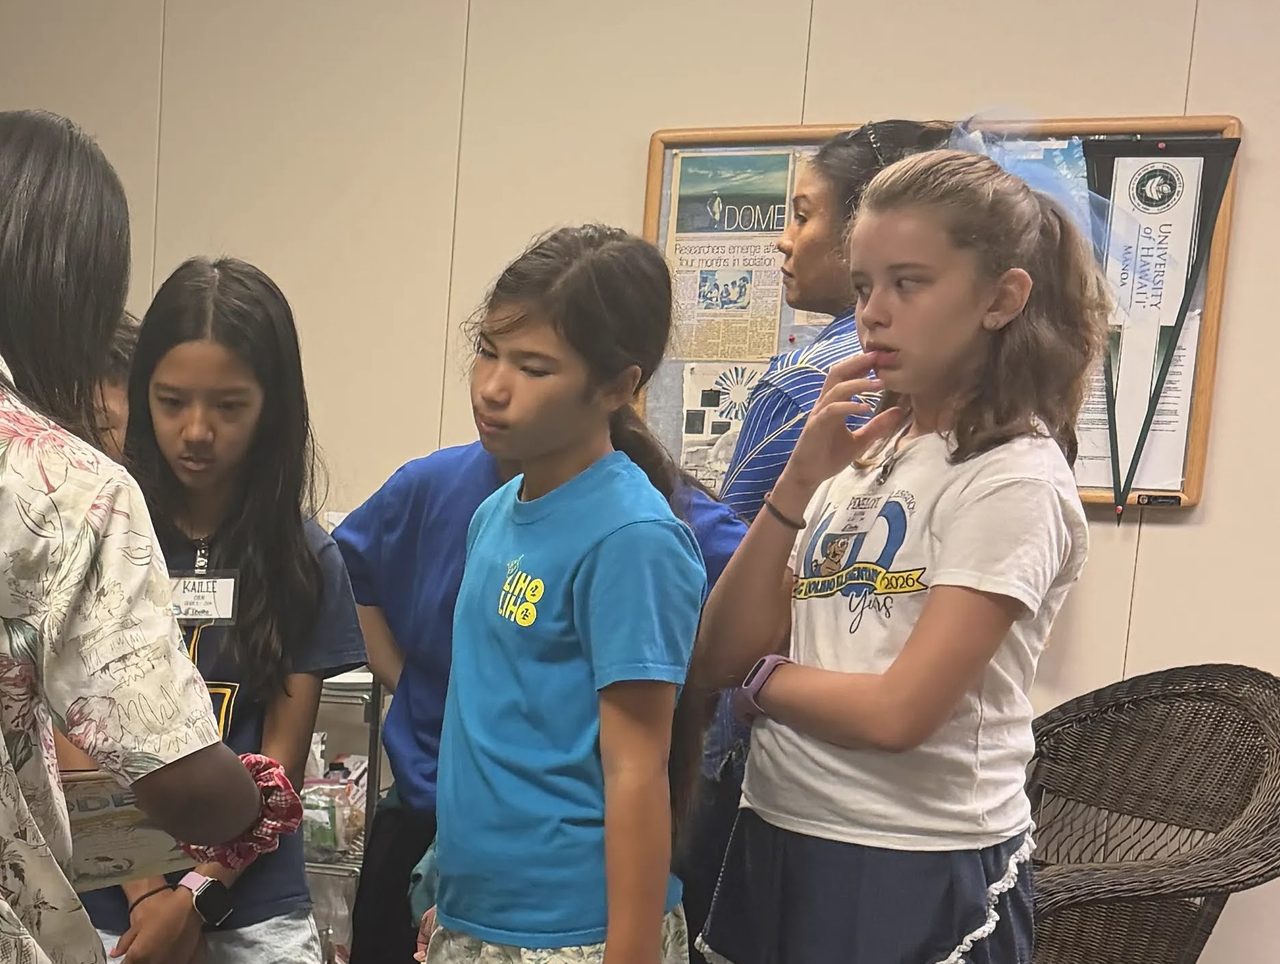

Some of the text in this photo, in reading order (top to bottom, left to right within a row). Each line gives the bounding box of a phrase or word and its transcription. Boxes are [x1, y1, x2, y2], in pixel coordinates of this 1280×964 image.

[1140, 226, 1156, 241] of
[674, 242, 726, 255] Researchers
[728, 244, 761, 256] emerge
[679, 256, 776, 269] four months in isolation
[1149, 223, 1173, 310] UNIVERSITY
[182, 580, 218, 594] KAILEE
[502, 570, 545, 604] LIHO
[883, 573, 915, 589] 2026
[498, 590, 537, 627] LIHO
